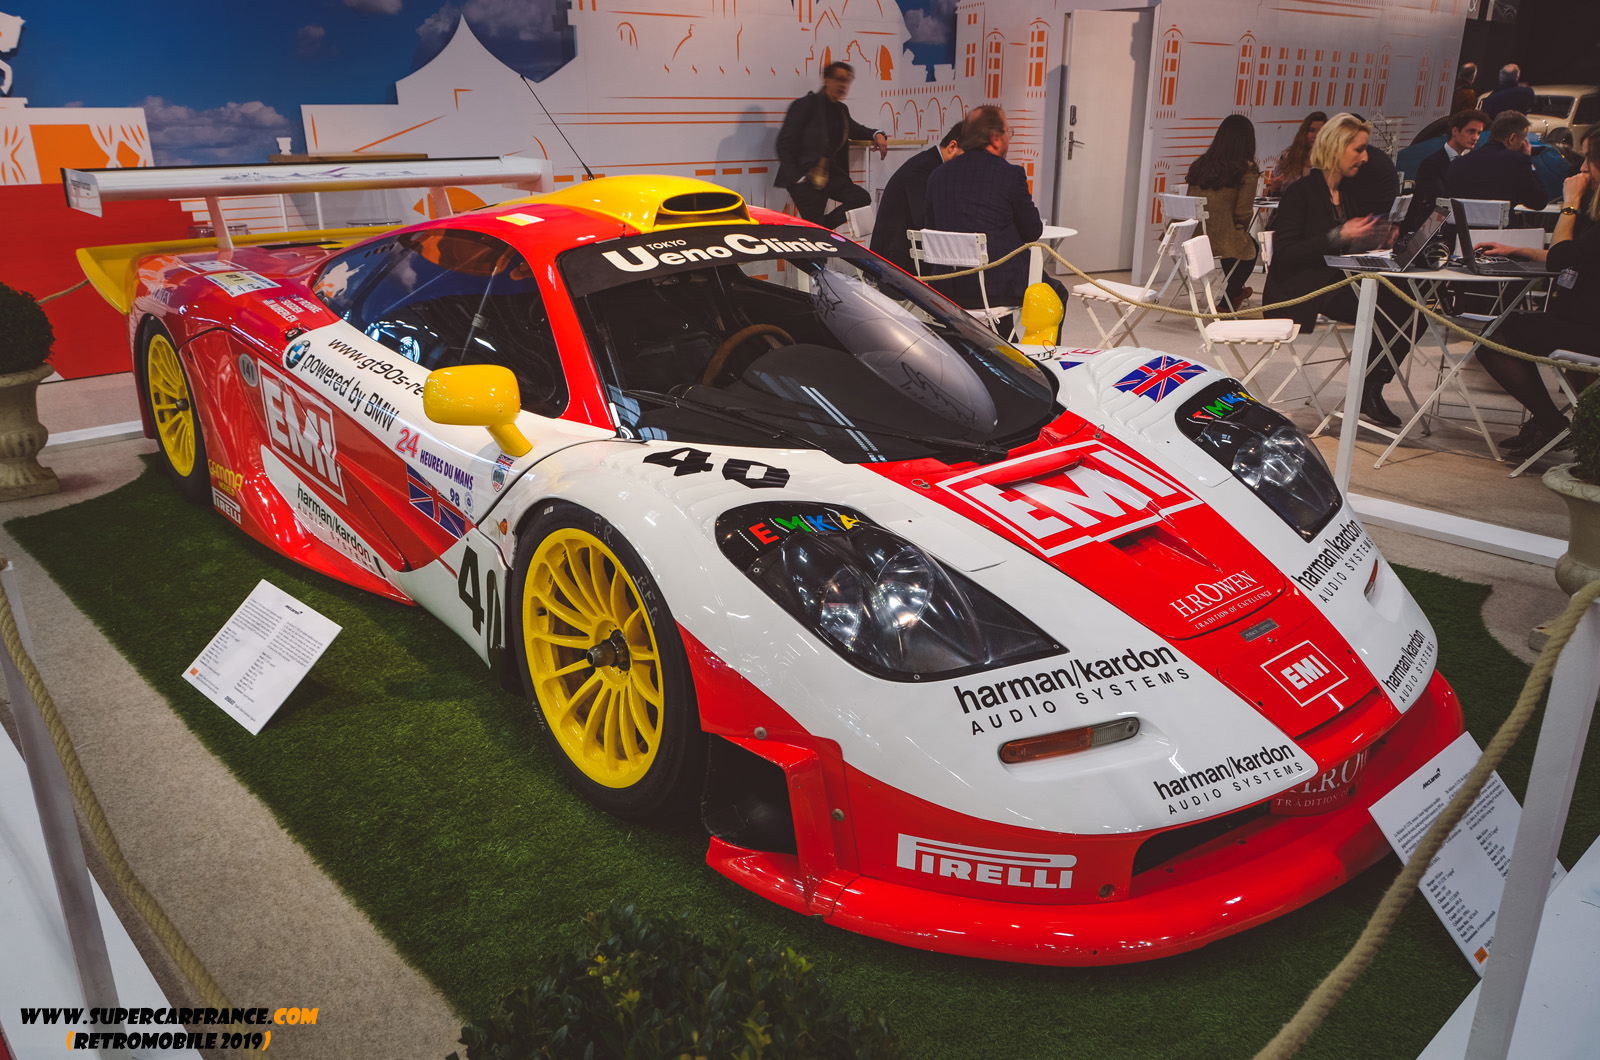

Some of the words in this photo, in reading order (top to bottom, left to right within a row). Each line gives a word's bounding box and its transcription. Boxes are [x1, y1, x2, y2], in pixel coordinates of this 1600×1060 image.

[647, 239, 687, 251] TOKYO
[301, 353, 355, 397] powered
[348, 381, 367, 412] by
[364, 392, 400, 432] BMW
[328, 338, 424, 397] www.gt90s-re
[262, 374, 340, 487] EMI
[395, 427, 421, 458] 24
[208, 459, 243, 491] GAMMA
[219, 481, 235, 497] MODELS
[420, 449, 444, 474] HEURES
[444, 462, 454, 480] DU
[454, 469, 474, 491] MANS
[643, 447, 790, 489] 40
[964, 450, 1178, 540] EMI
[212, 486, 242, 525] PIRELLI
[297, 503, 324, 528] AUDIO
[297, 483, 371, 563] harman/kardon
[450, 488, 460, 507] 98
[748, 514, 862, 545] EMKA
[1291, 519, 1363, 592] harman/kardon
[1319, 575, 1347, 603] AUDIO
[1348, 537, 1375, 572] SYSTEMS
[458, 545, 502, 656] 40
[1195, 611, 1230, 630] TRADITION
[1229, 605, 1237, 613] OF
[1237, 590, 1273, 609] EXCELLENCE
[954, 646, 1179, 713] harman/kardon
[1280, 654, 1331, 691] EMI
[1382, 629, 1426, 693] harman/kardon
[1399, 675, 1418, 703] AUDIO
[1418, 641, 1435, 674] SYSTEMS
[970, 701, 1058, 736] AUDIO
[1075, 667, 1191, 705] SYSTEMS
[1153, 742, 1295, 801] harman/kardon
[1168, 789, 1223, 815] AUDIO
[1233, 761, 1304, 793] SYSTEMS
[1276, 788, 1339, 807] TRADITION
[1422, 769, 1442, 789] McLaren
[897, 833, 1077, 890] PIRELLI
